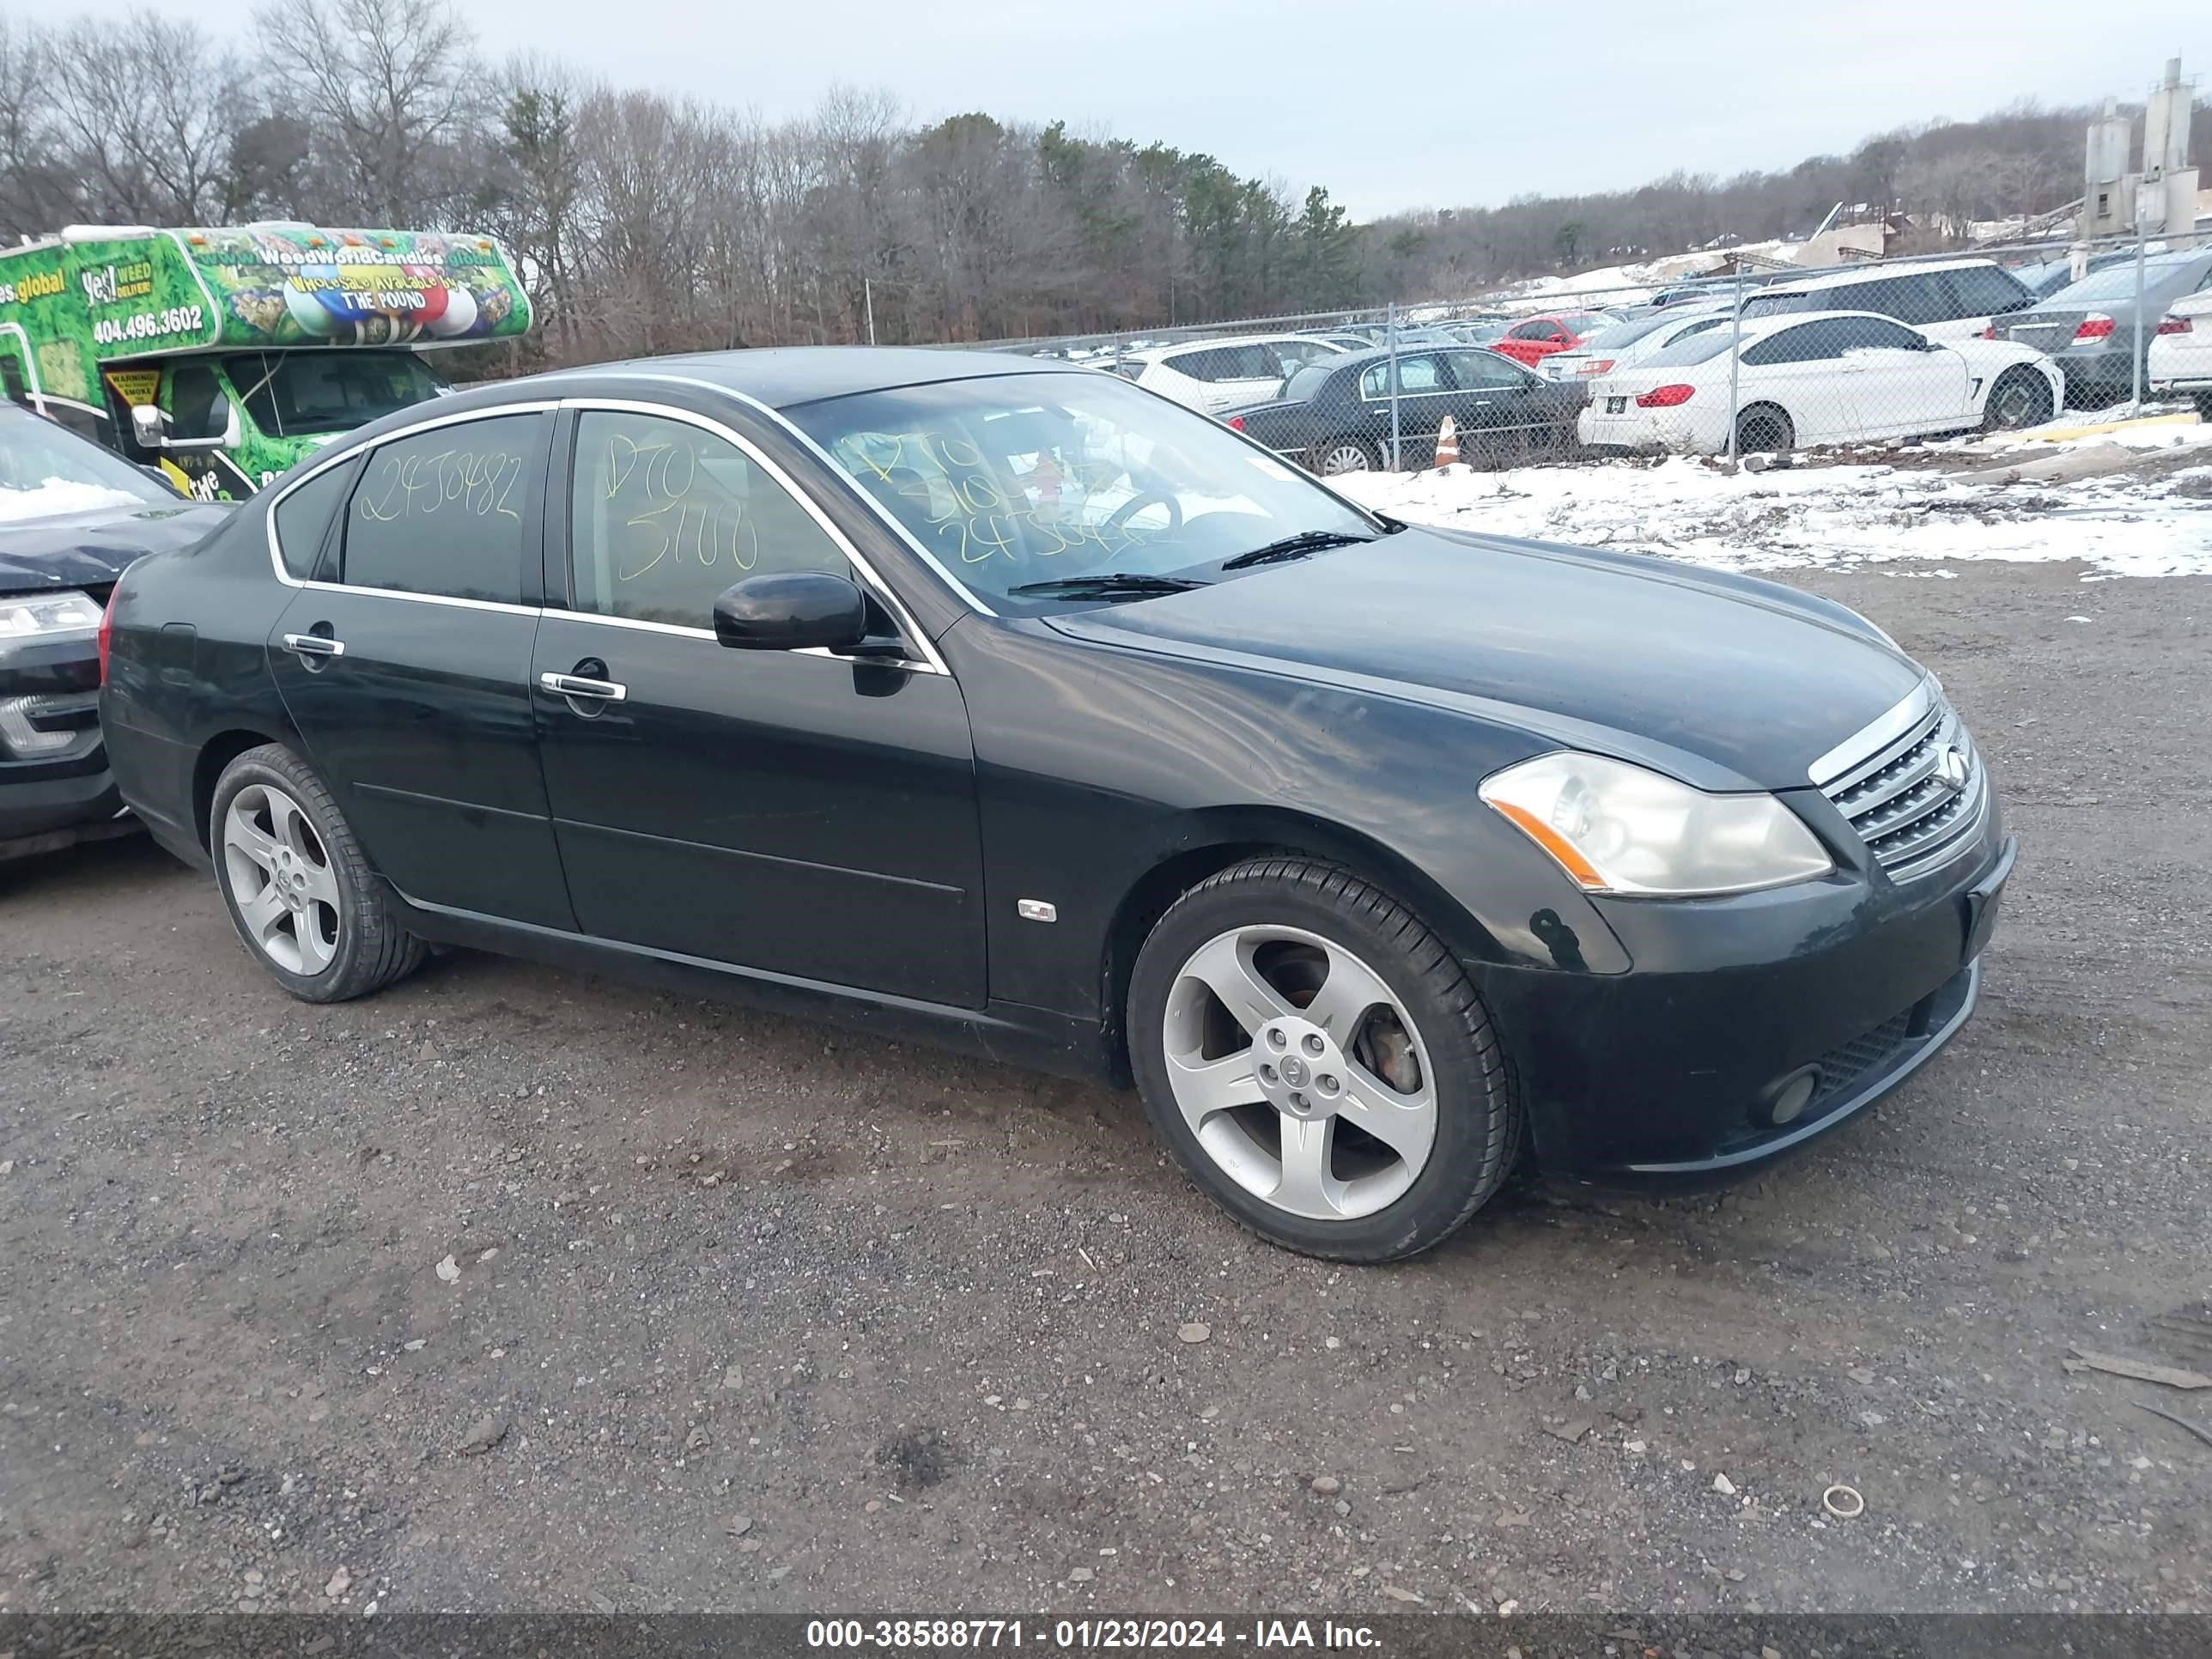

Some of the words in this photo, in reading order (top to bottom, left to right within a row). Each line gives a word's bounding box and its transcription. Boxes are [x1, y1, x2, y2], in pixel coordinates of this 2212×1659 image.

[117, 262, 151, 283] WEED
[340, 291, 376, 310] THE
[380, 290, 426, 309] POUND
[93, 305, 203, 344] 404.496.3602
